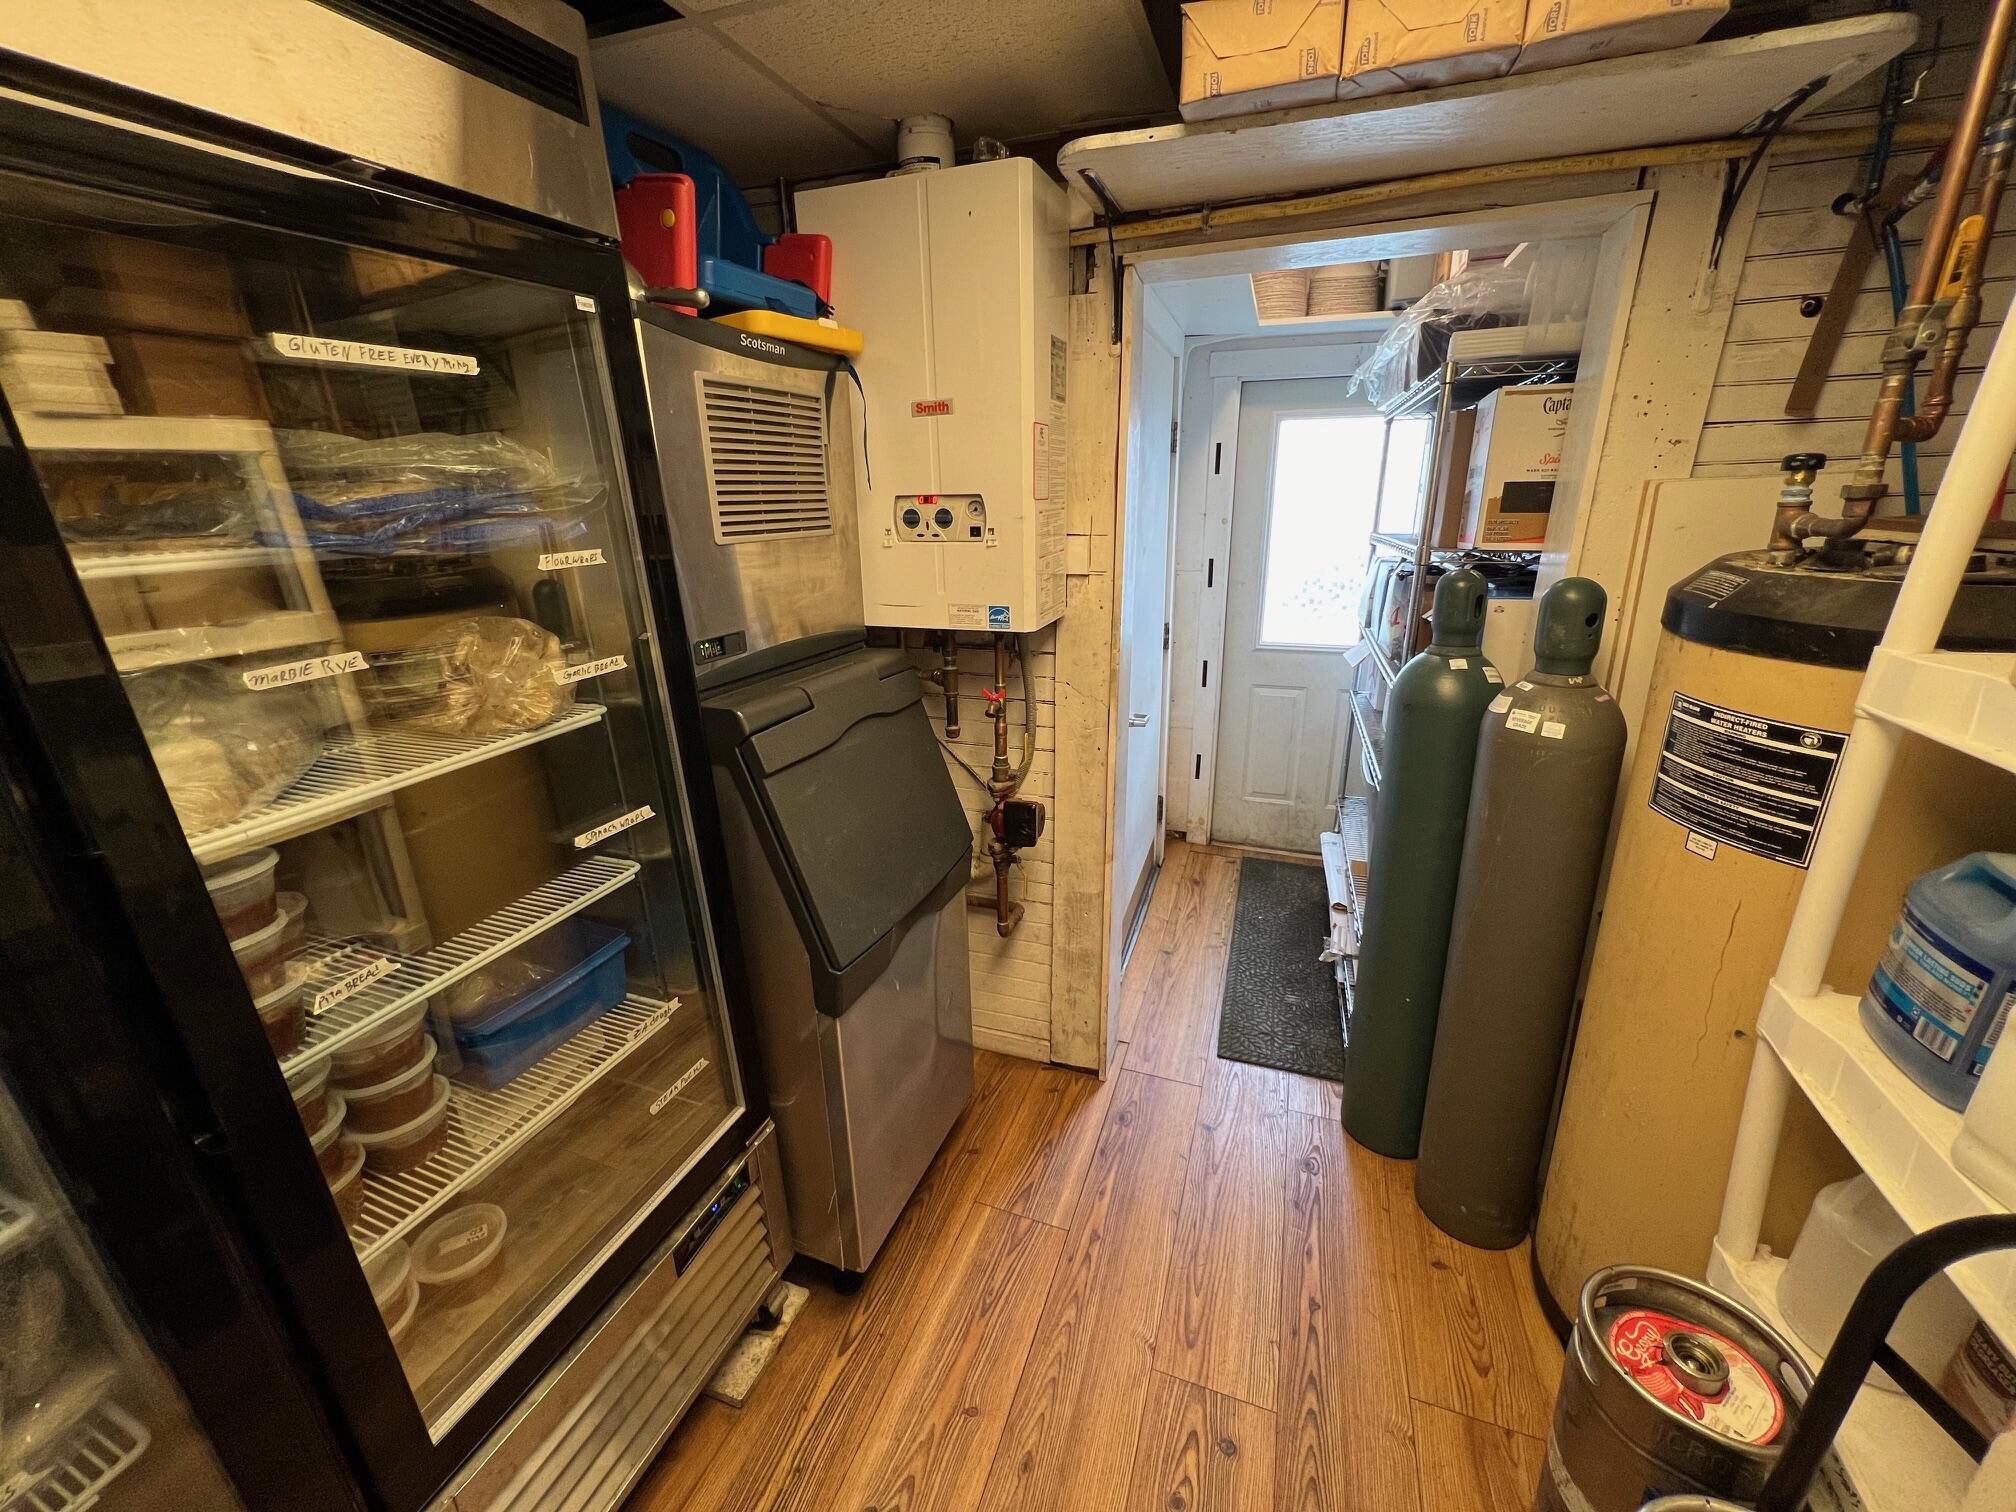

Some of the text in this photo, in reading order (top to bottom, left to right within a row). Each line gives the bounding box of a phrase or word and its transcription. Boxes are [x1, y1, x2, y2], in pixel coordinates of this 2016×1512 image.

[1467, 13, 1480, 43] TORK
[1546, 1, 1561, 33] TORK
[1306, 48, 1315, 75] TORK
[1360, 38, 1371, 65] TORK
[1210, 72, 1219, 97] TORK
[359, 347, 396, 363] FREE
[740, 333, 786, 356] Scotsman
[915, 401, 949, 414] Smith
[1543, 396, 1572, 415] Capta
[1710, 717, 1768, 738] WATER HEATERS
[1713, 710, 1769, 730] INDIRECT-FIRED
